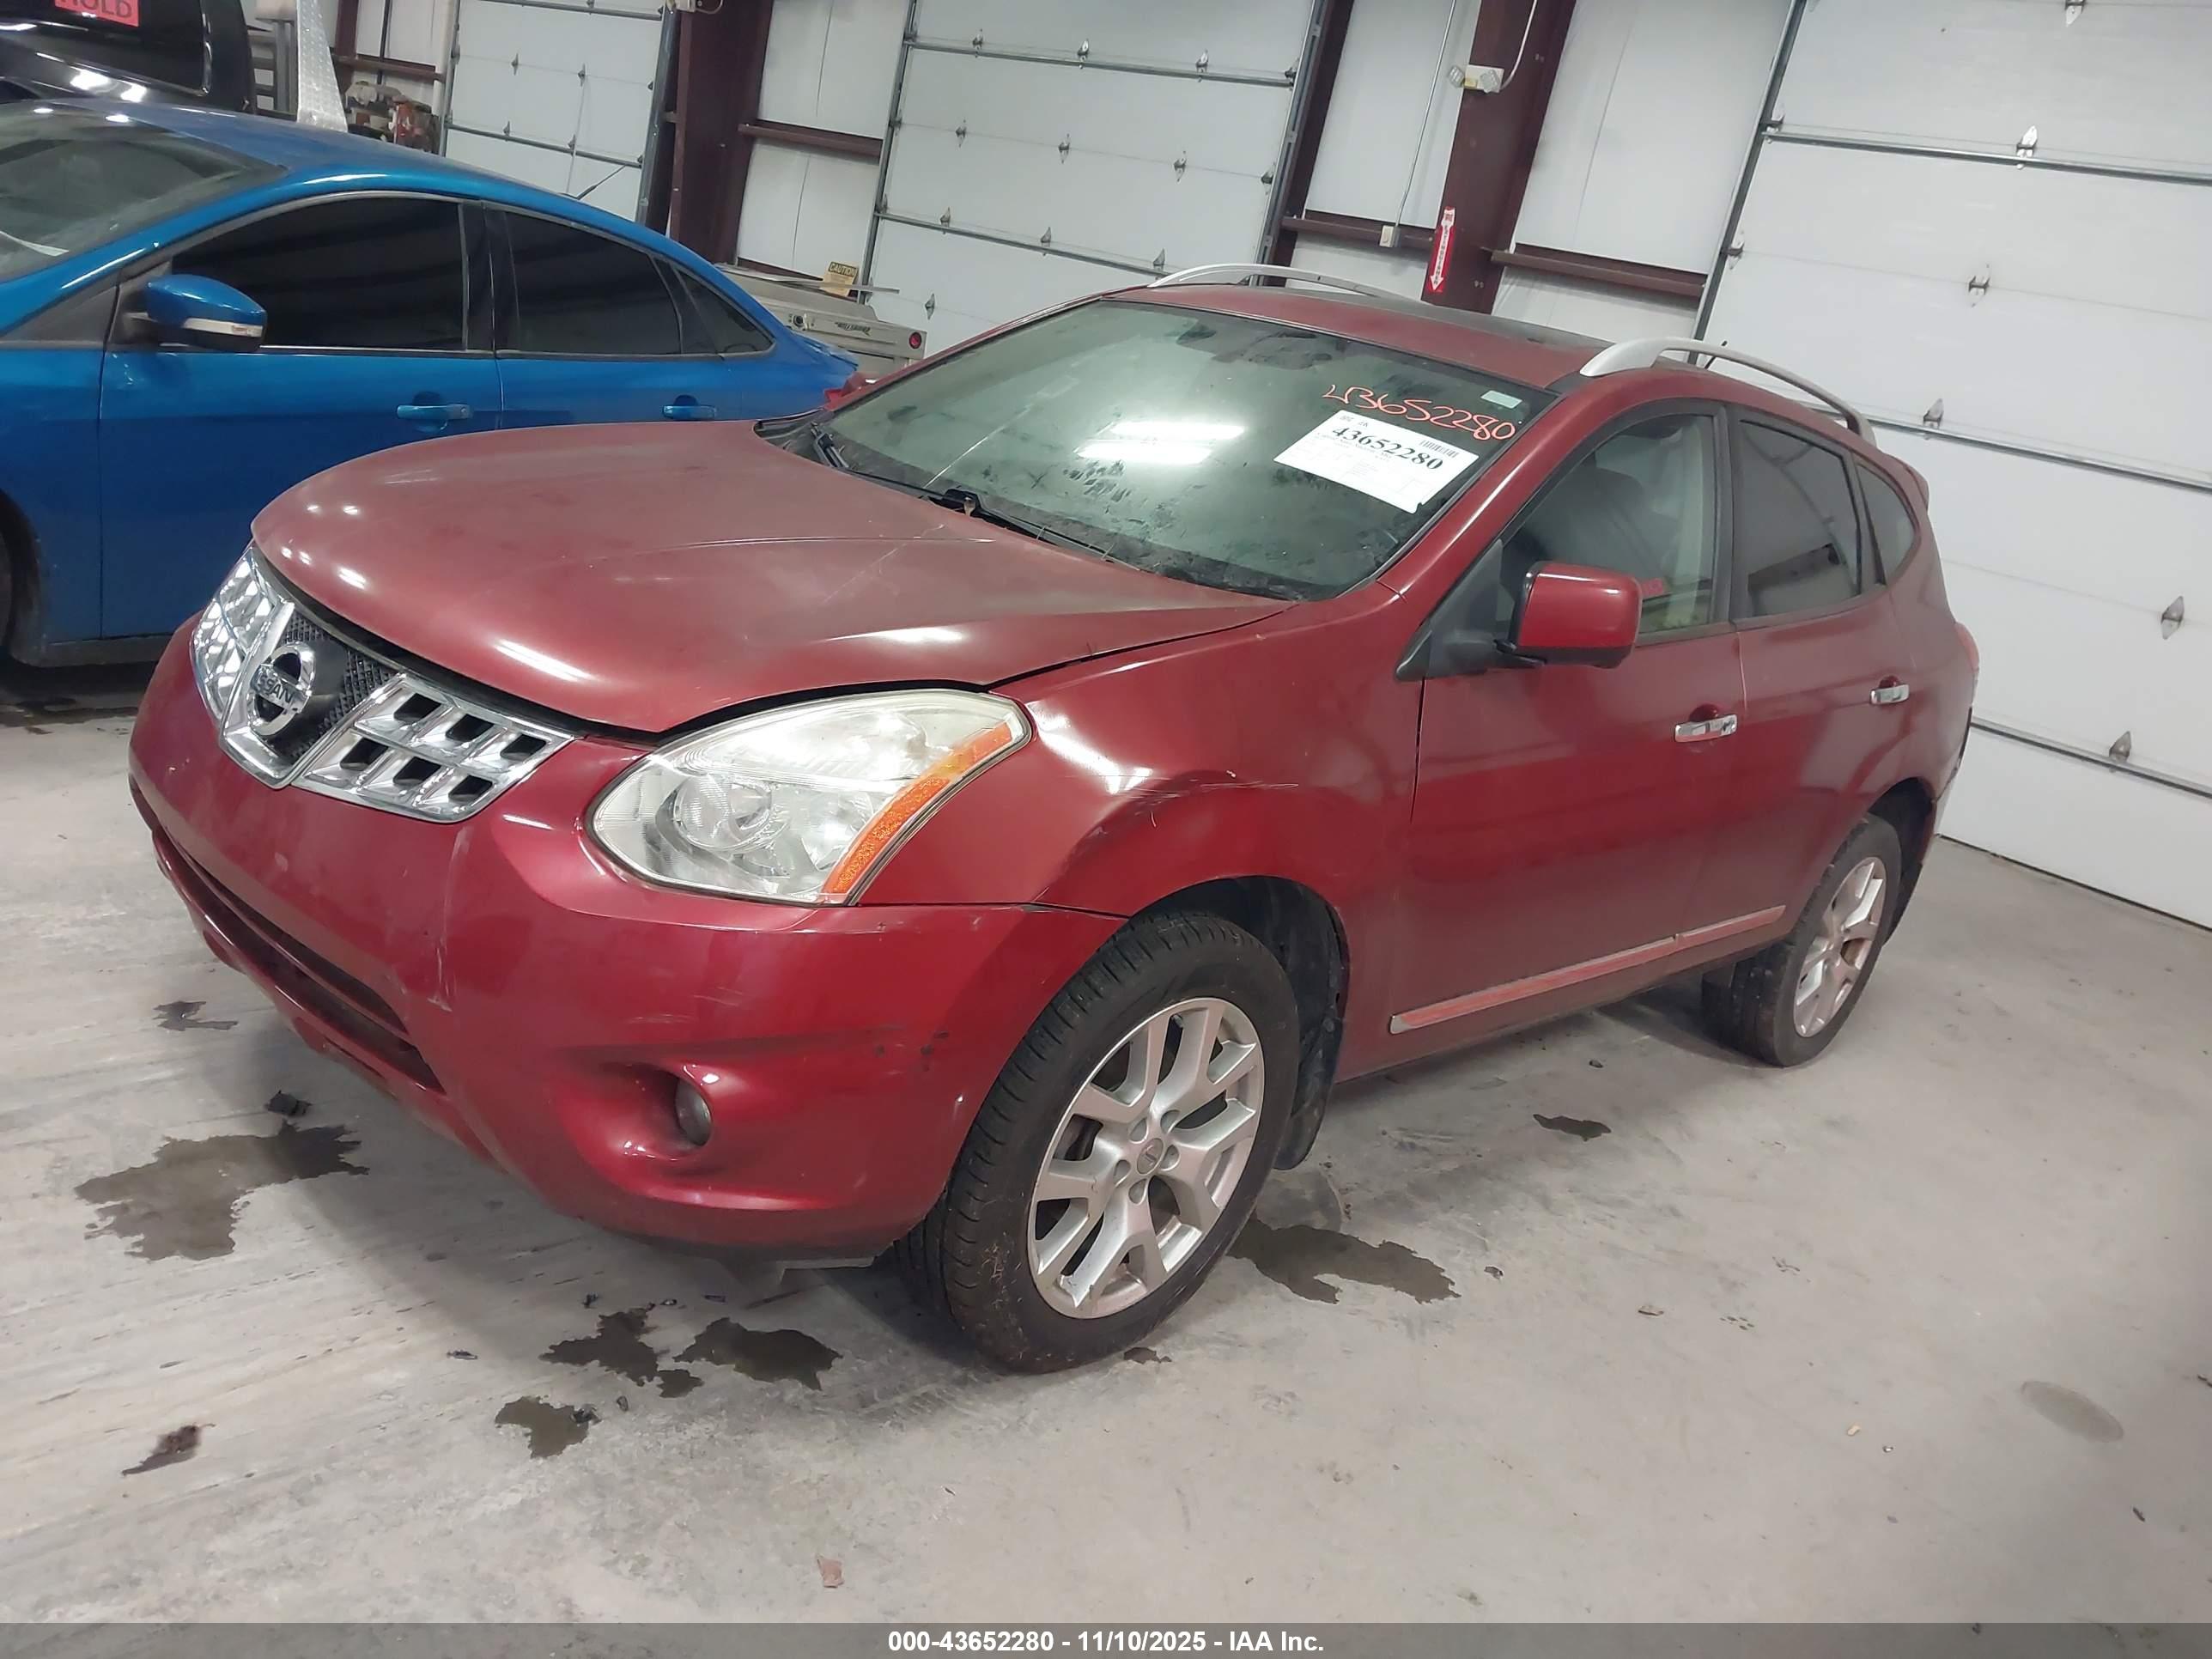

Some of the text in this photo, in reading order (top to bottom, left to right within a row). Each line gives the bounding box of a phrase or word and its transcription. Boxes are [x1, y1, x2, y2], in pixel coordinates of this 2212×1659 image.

[59, 0, 132, 17] OLD
[830, 263, 857, 276] CAUTION
[1322, 385, 1516, 441] 43652280
[1333, 428, 1443, 470] 43652280
